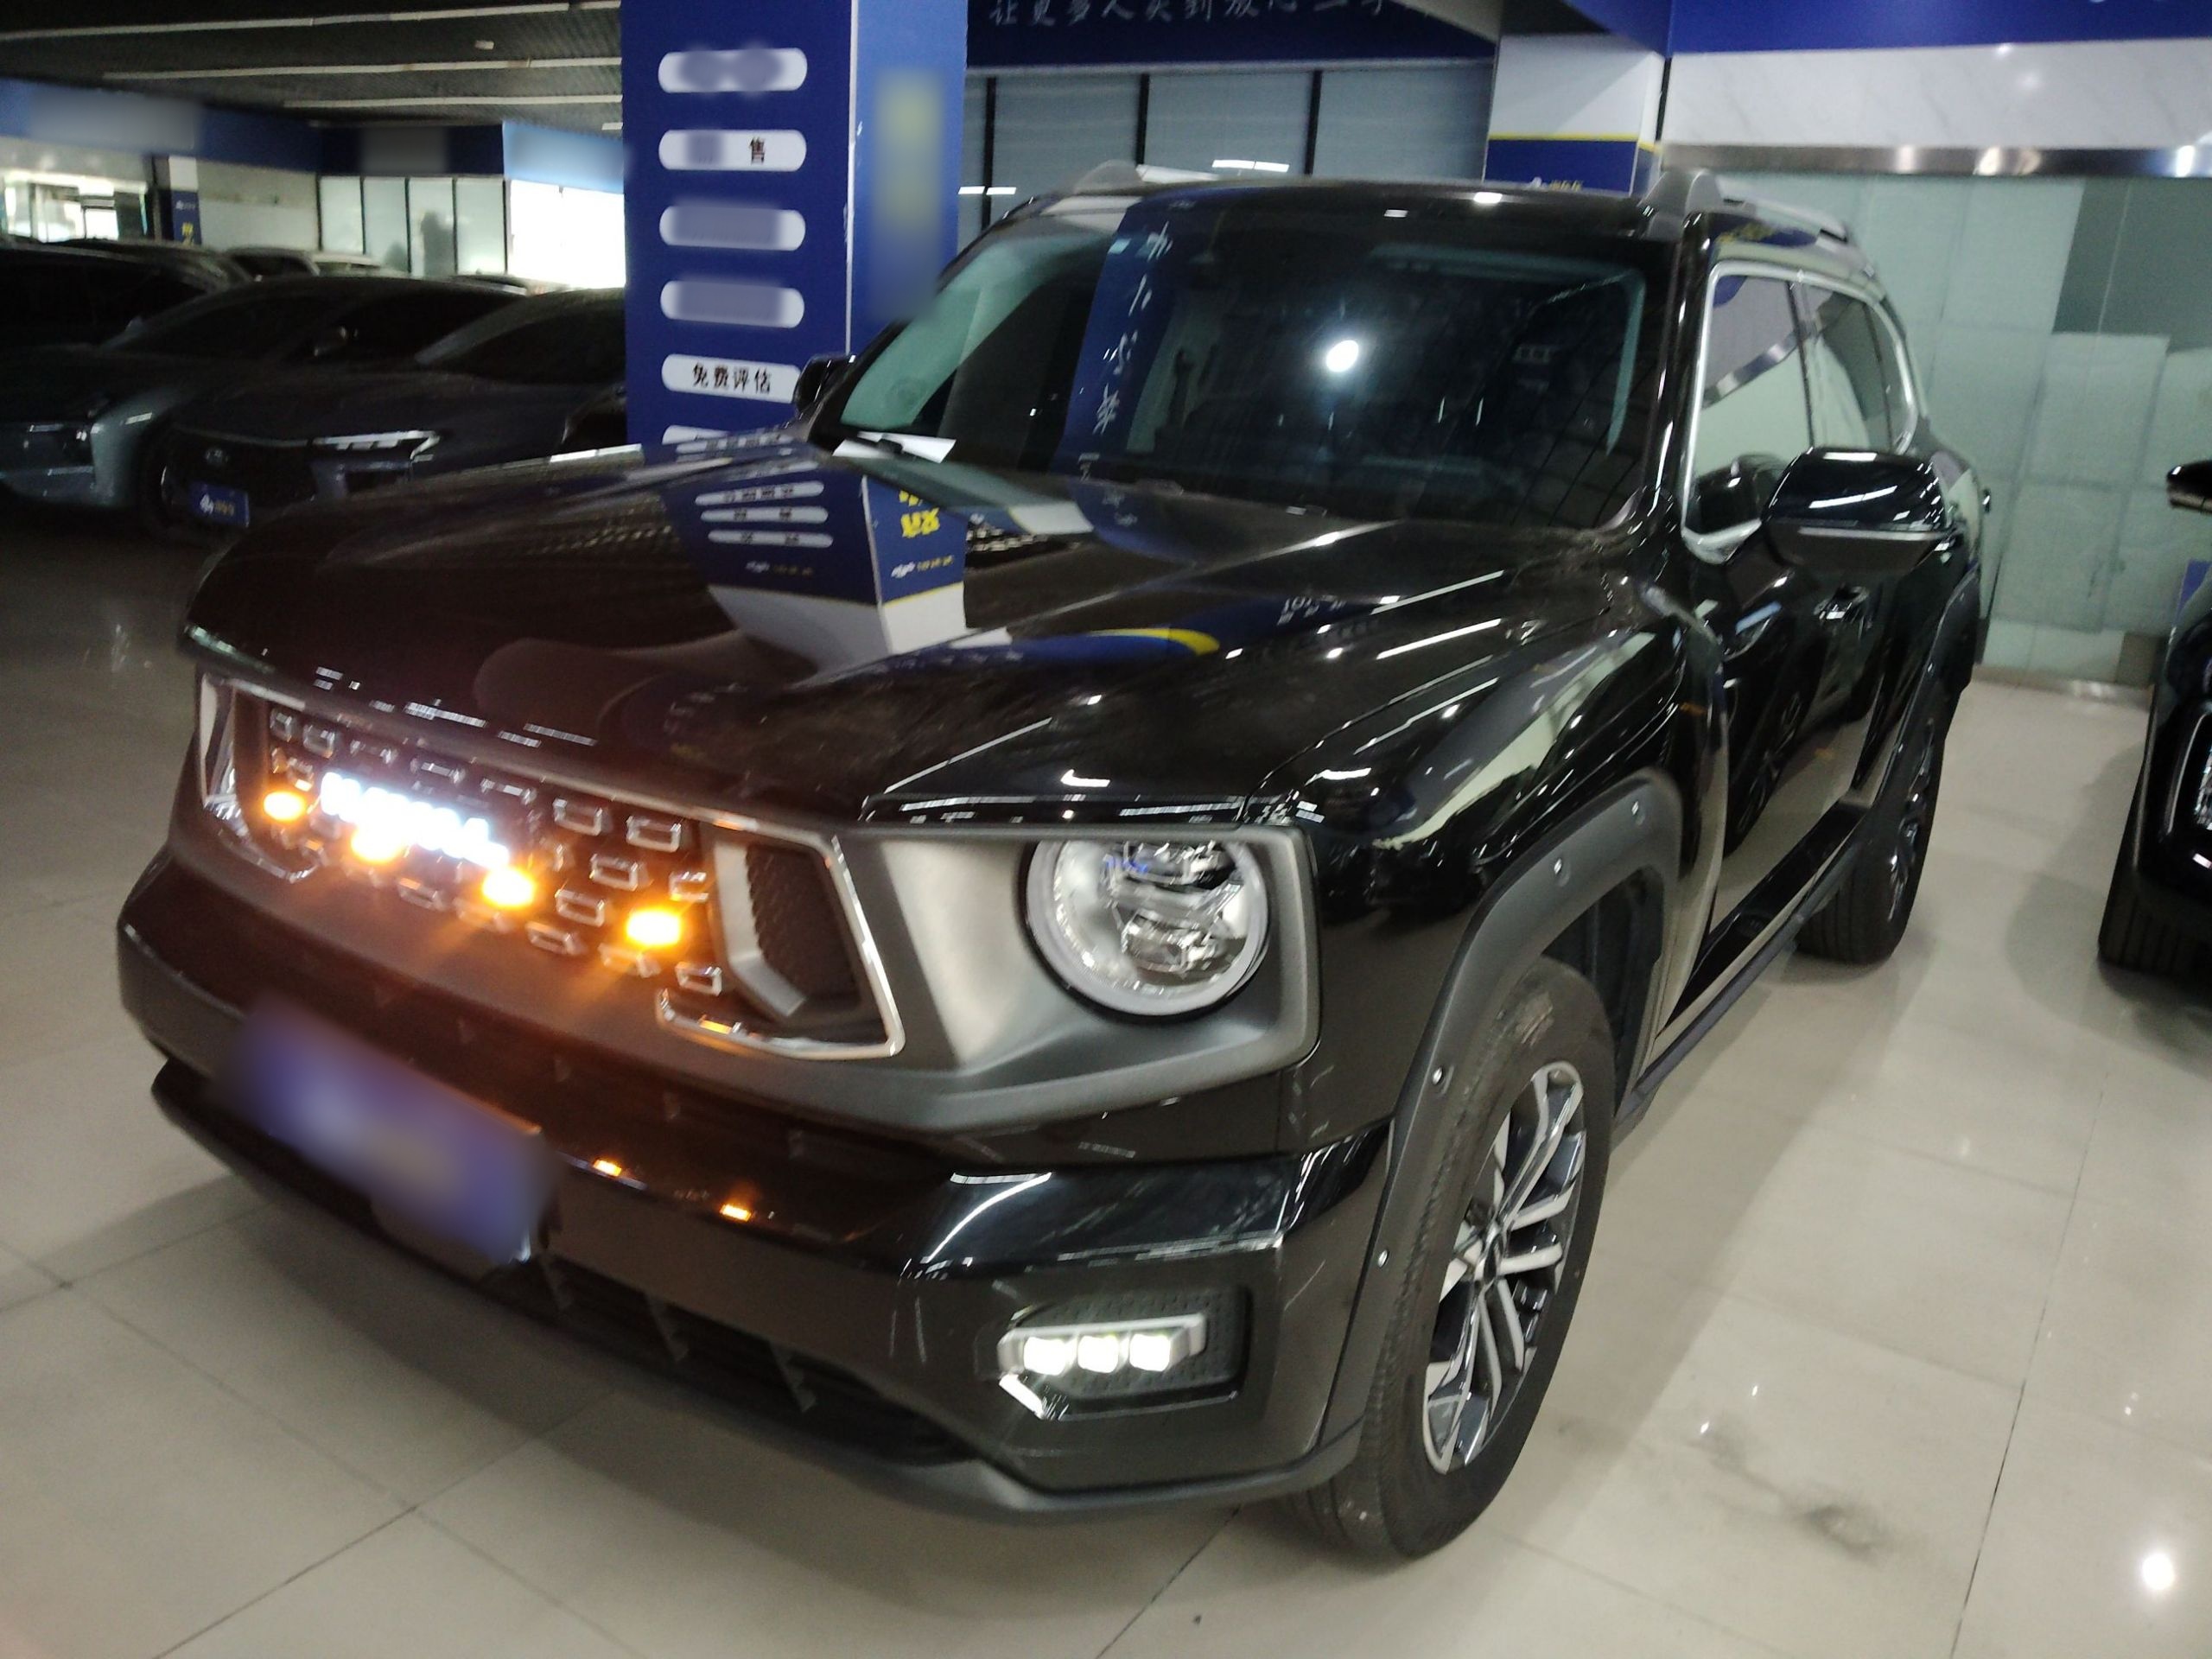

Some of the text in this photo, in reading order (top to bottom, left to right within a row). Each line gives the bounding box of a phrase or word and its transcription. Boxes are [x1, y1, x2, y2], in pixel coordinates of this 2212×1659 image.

[749, 136, 766, 165] 售
[693, 362, 772, 394] 免费评估
